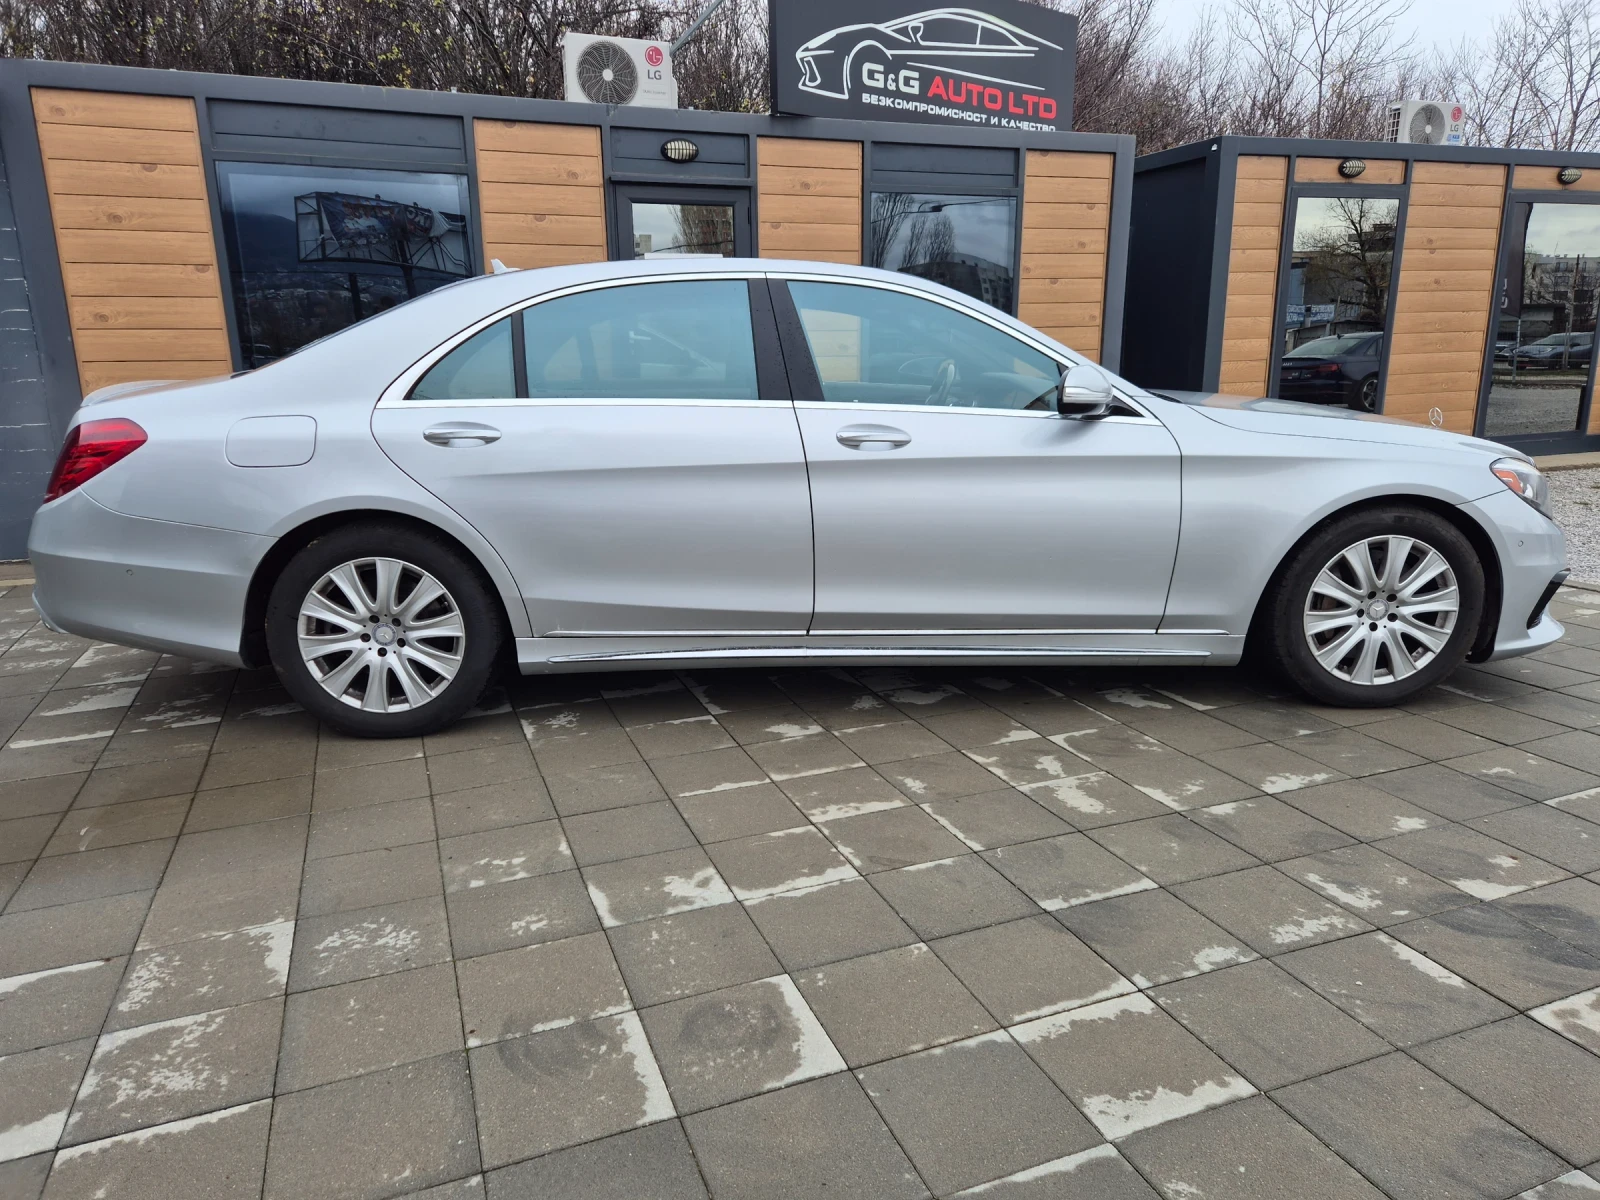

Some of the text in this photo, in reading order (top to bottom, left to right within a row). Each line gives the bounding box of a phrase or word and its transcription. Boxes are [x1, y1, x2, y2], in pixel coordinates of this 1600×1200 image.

[647, 69, 662, 80] LG
[862, 62, 1057, 119] G&G AUTO LTD
[862, 92, 987, 124] БЕЗКОМПРОМИСНОСТ
[990, 115, 999, 126] И
[1450, 124, 1459, 132] LG
